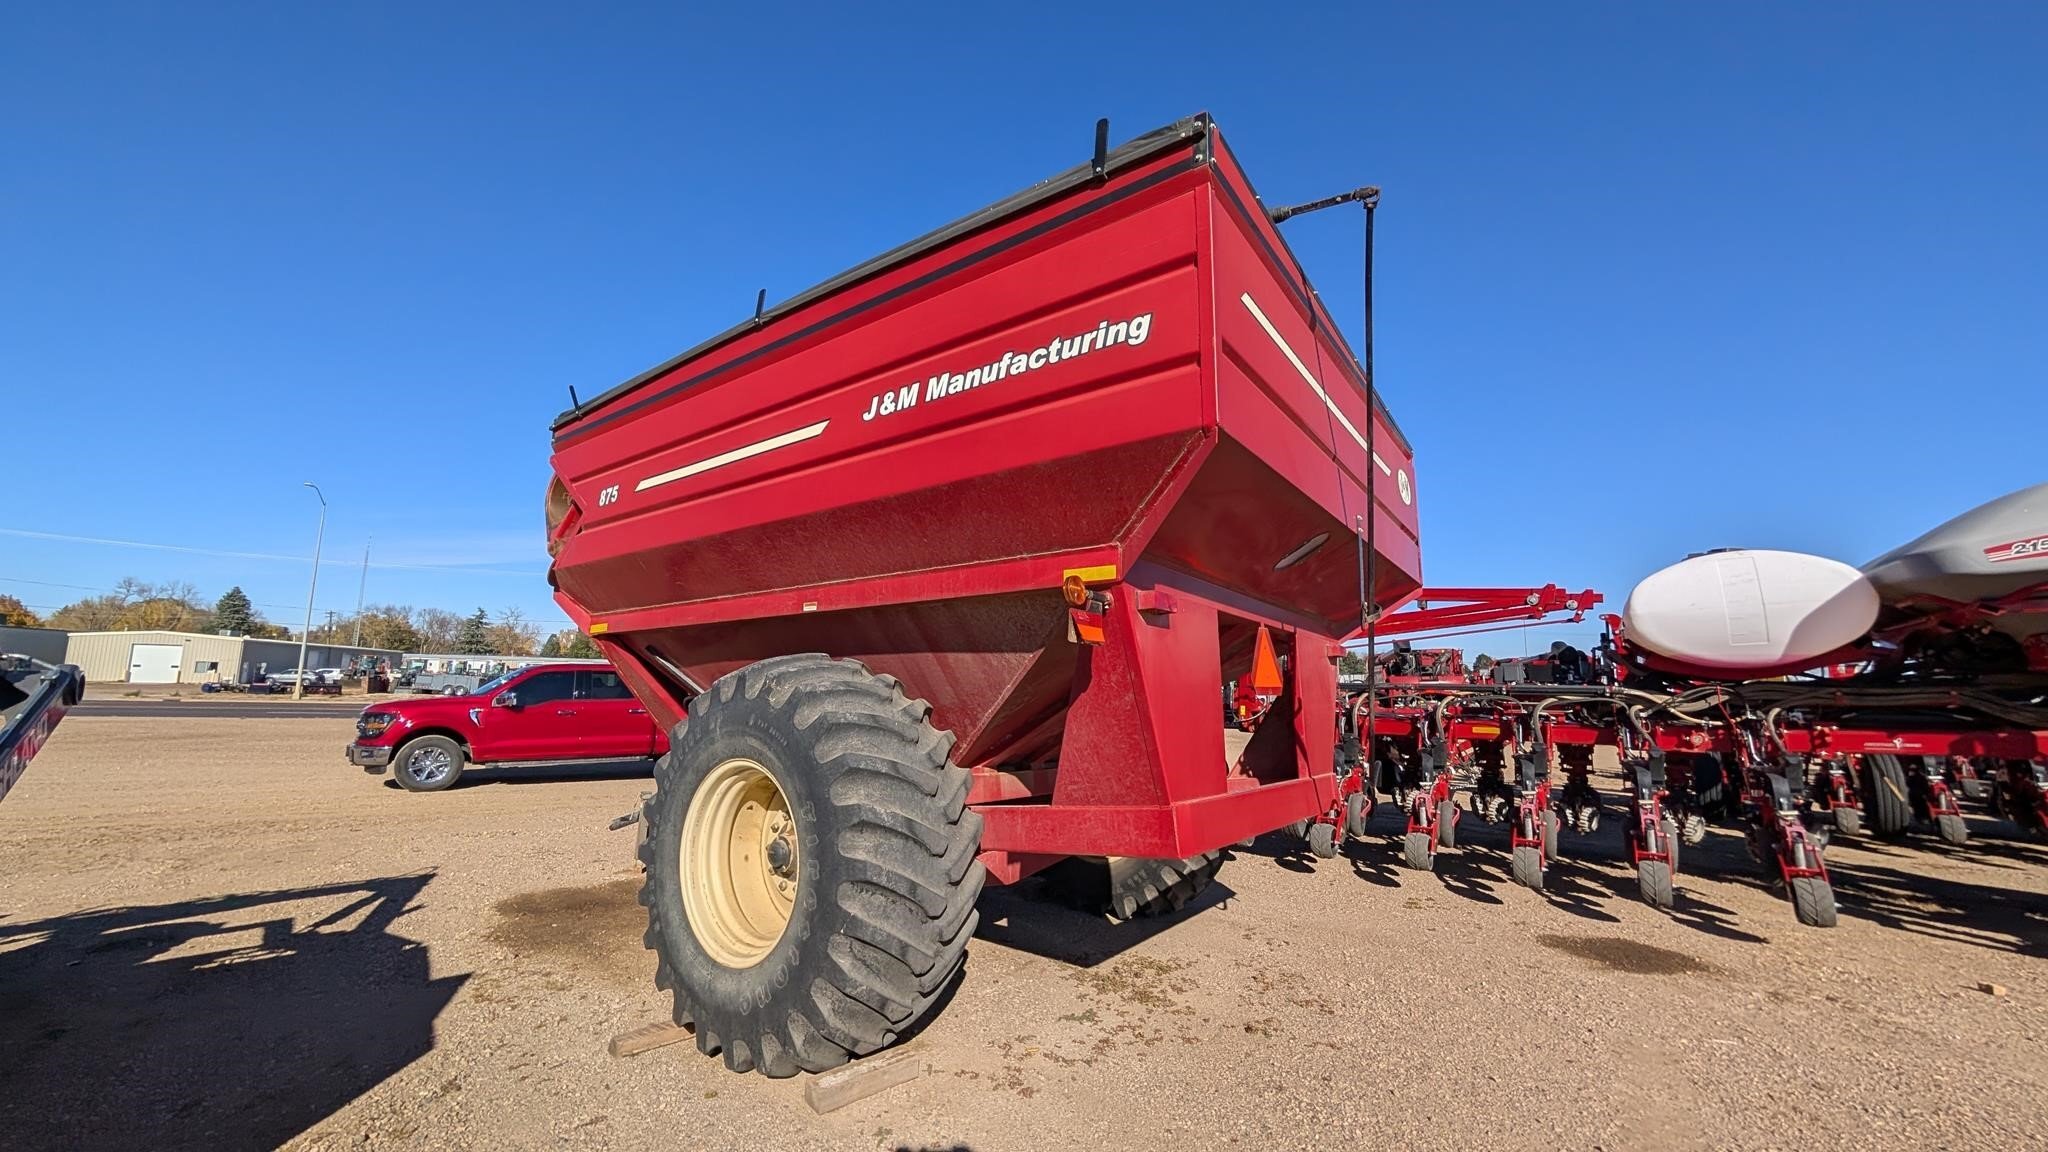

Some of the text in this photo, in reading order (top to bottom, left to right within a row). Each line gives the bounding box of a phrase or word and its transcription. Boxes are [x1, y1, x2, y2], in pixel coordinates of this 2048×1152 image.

[861, 311, 1153, 422] J&M Manufacturing
[598, 484, 620, 507] 875
